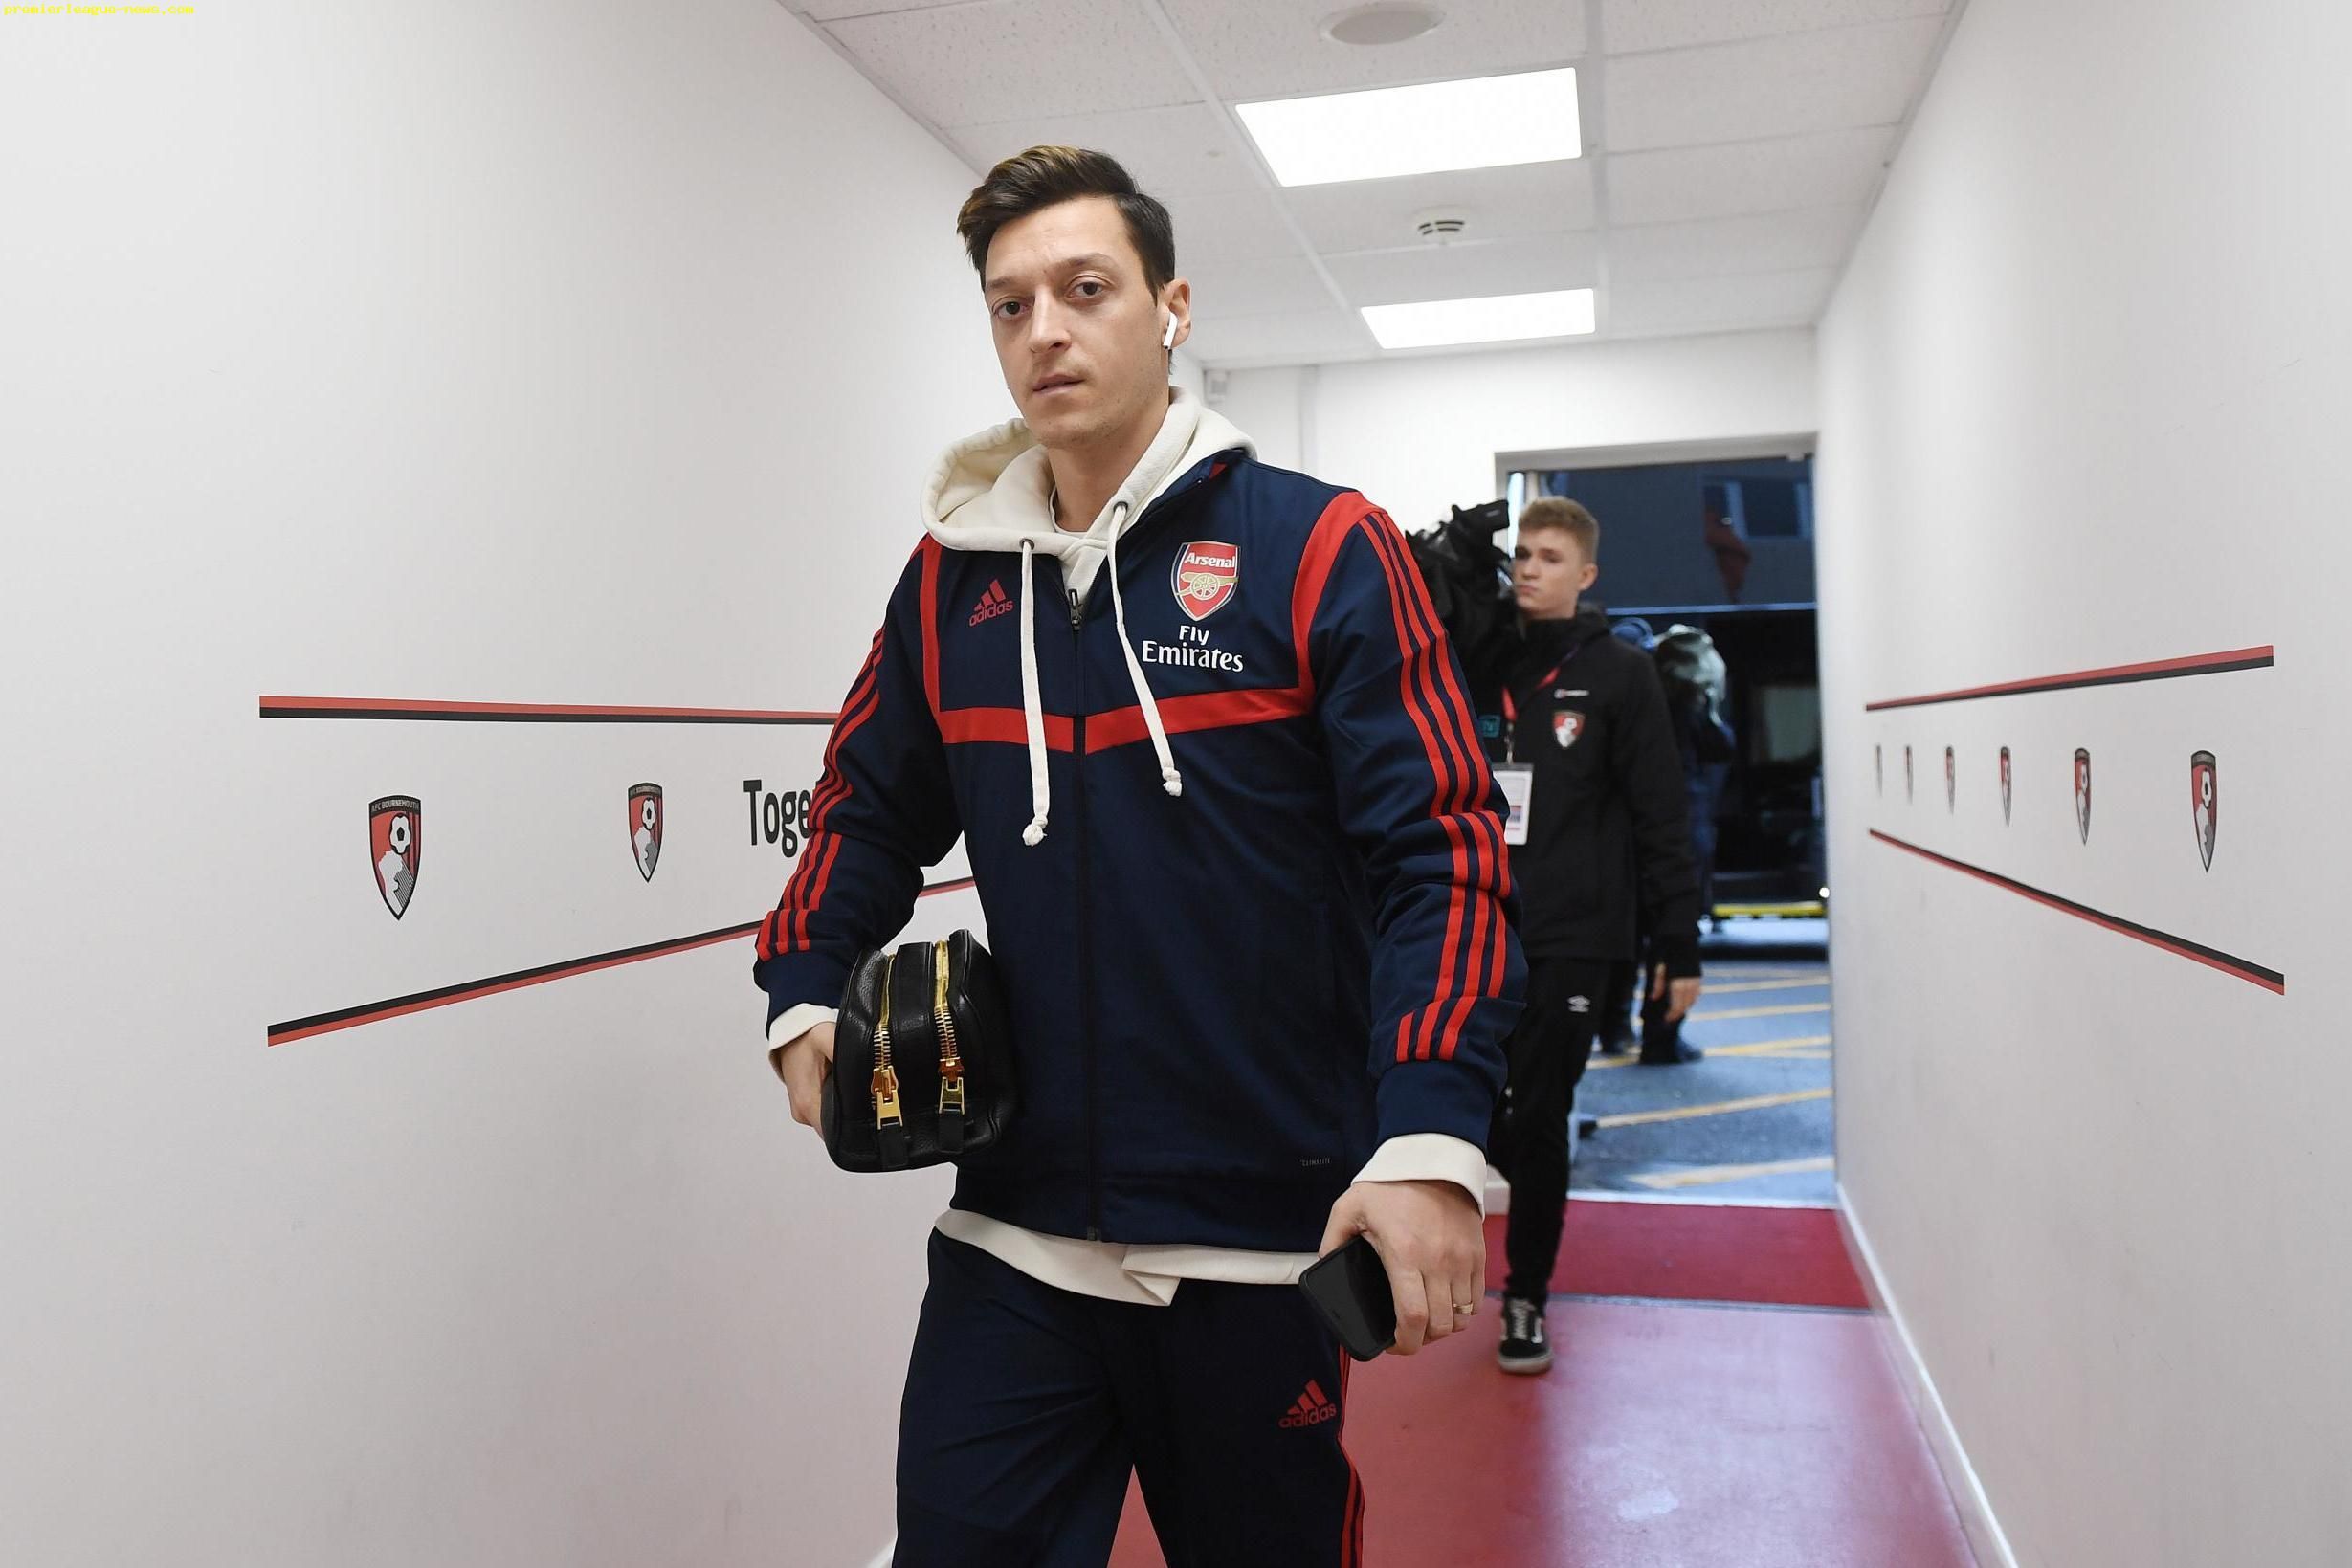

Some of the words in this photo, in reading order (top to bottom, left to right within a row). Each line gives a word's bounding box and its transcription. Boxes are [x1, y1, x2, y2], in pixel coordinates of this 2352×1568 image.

[1185, 552, 1236, 568] Arsenal
[969, 600, 1014, 627] adidas
[1179, 625, 1209, 646] Fly
[1142, 640, 1244, 673] Emirates
[1278, 1403, 1337, 1428] adidas
